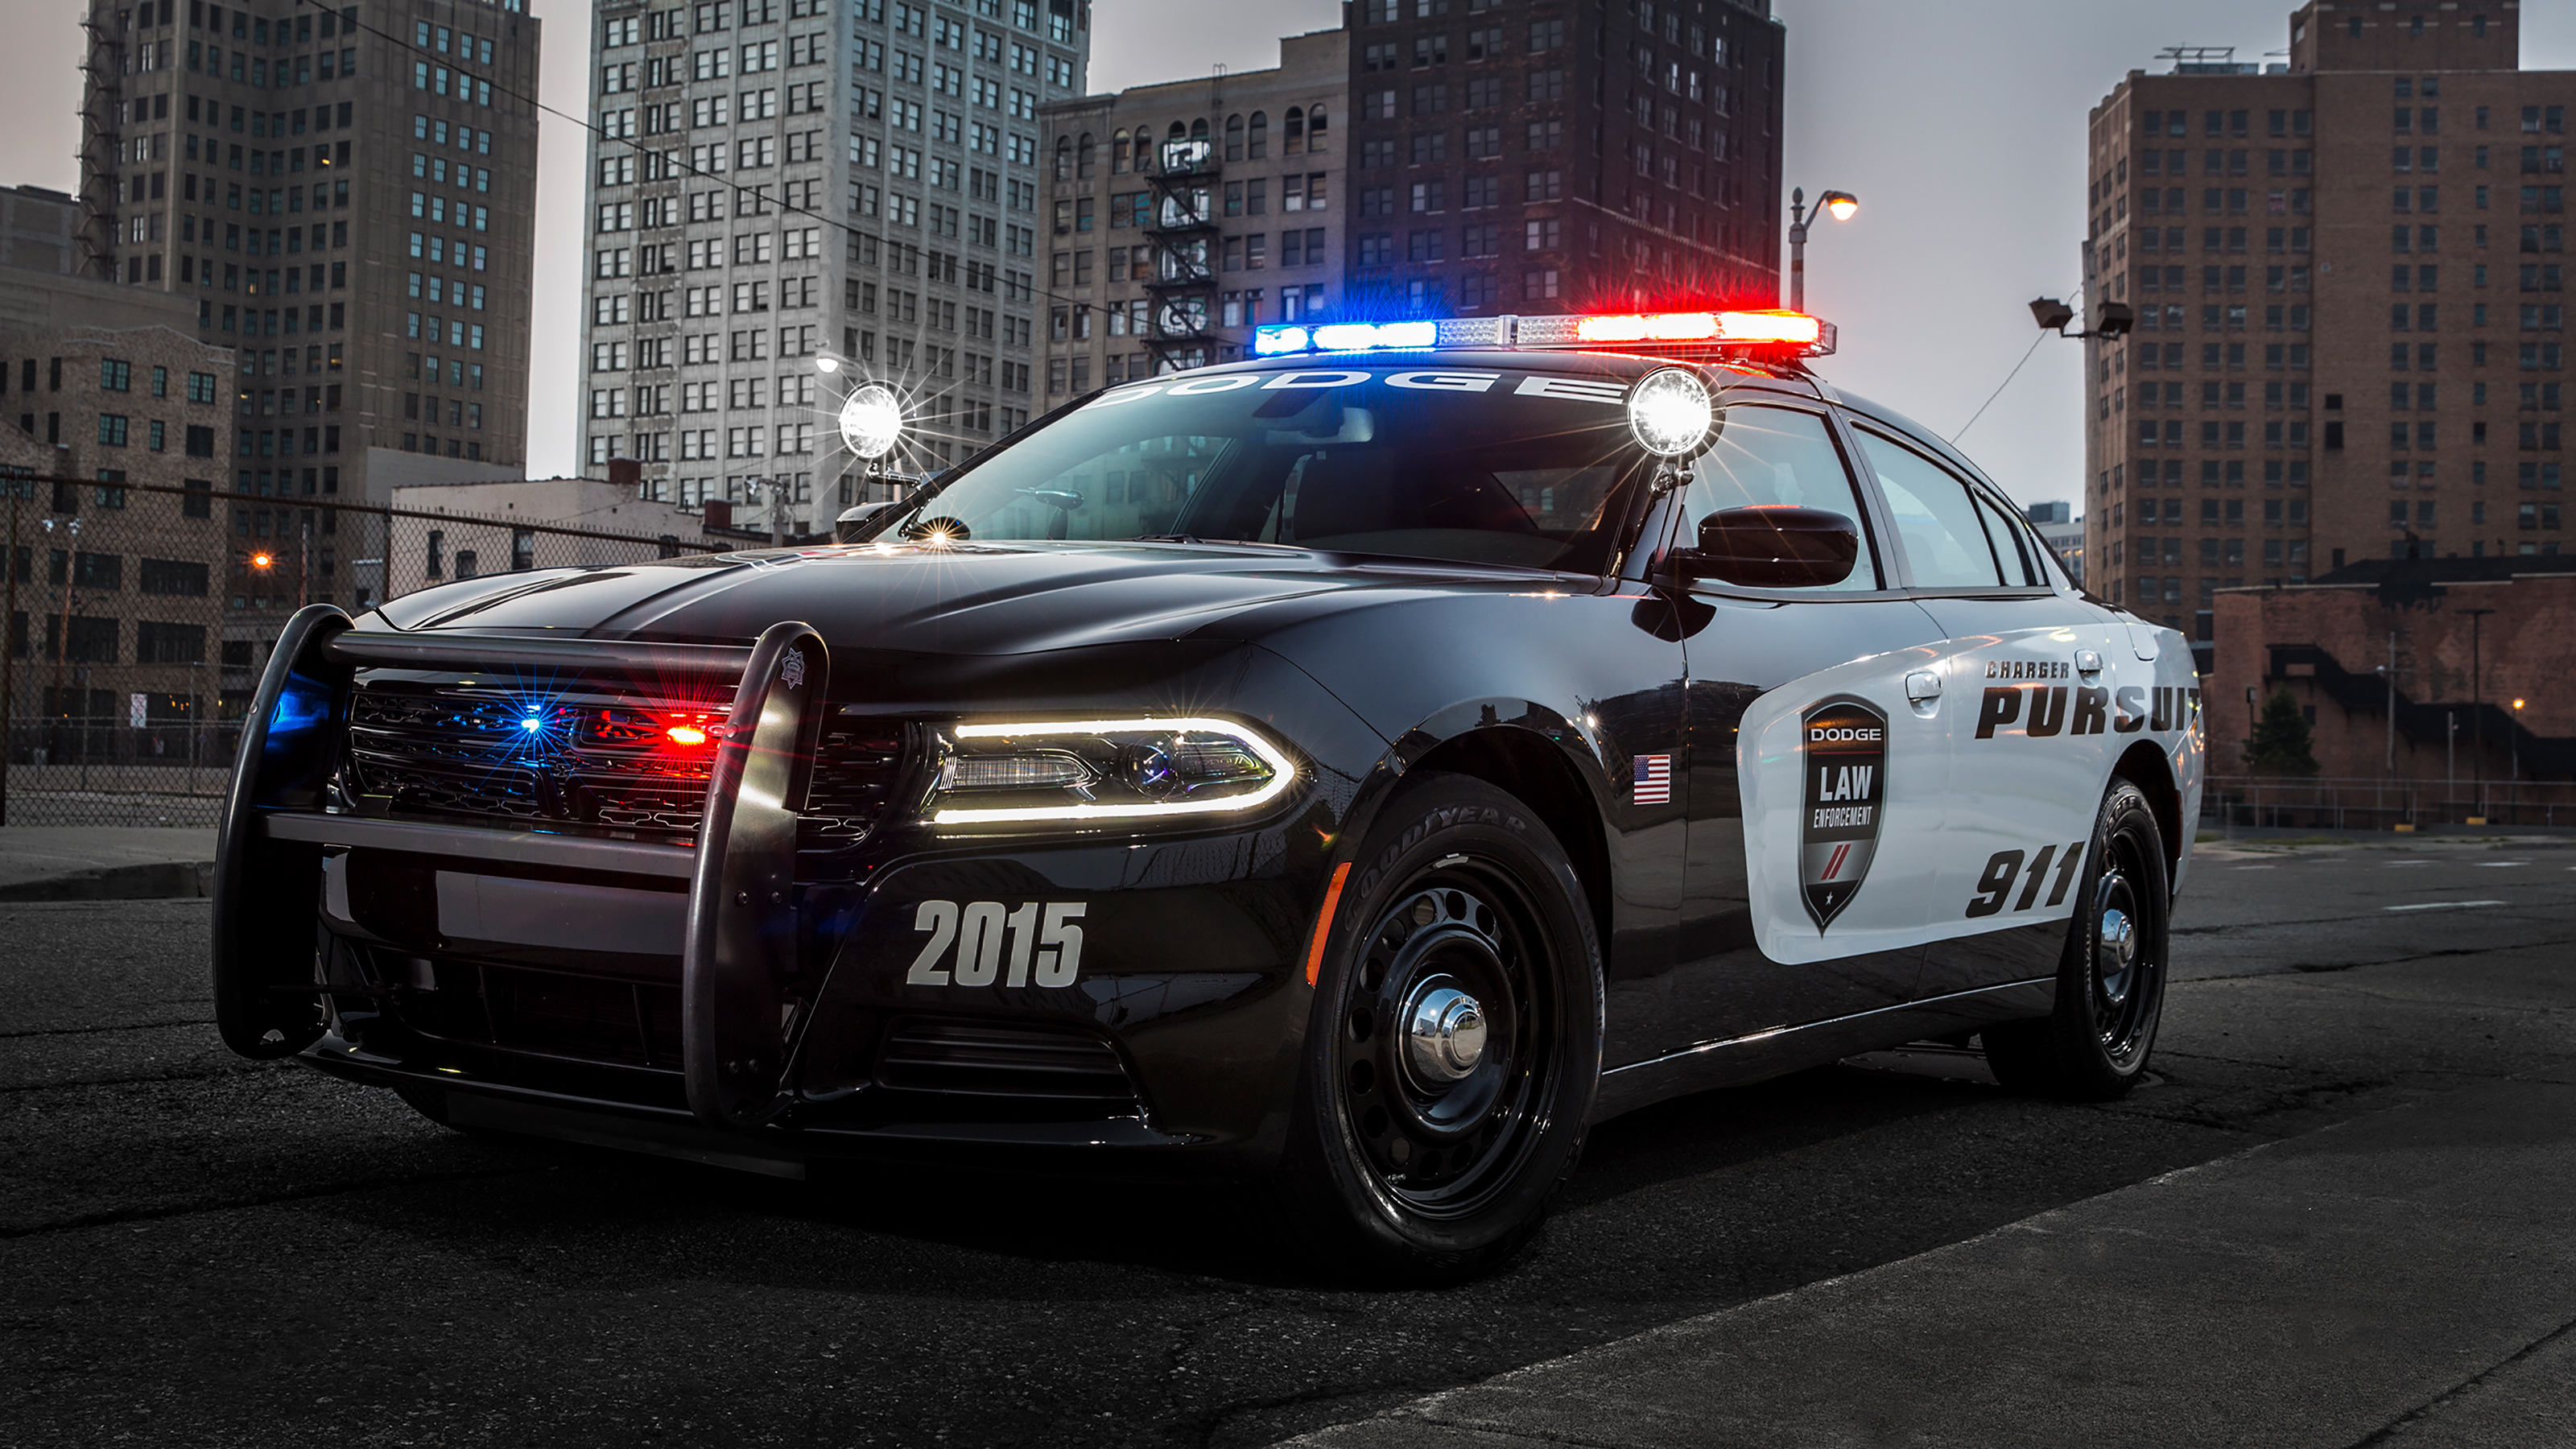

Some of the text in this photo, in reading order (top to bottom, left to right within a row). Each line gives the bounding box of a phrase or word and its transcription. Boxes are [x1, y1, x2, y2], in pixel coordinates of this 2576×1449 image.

[1079, 371, 1630, 411] DODGE
[1985, 660, 2070, 679] CHARGER
[1975, 686, 2199, 739] PURSUIT
[1811, 728, 1882, 741] DODGE
[1819, 766, 1873, 802] LAW
[1814, 806, 1872, 828] ENFORCEMENT
[1344, 806, 1527, 931] GOODYEAR
[1965, 840, 2086, 919] 911
[906, 900, 1087, 987] 2015
